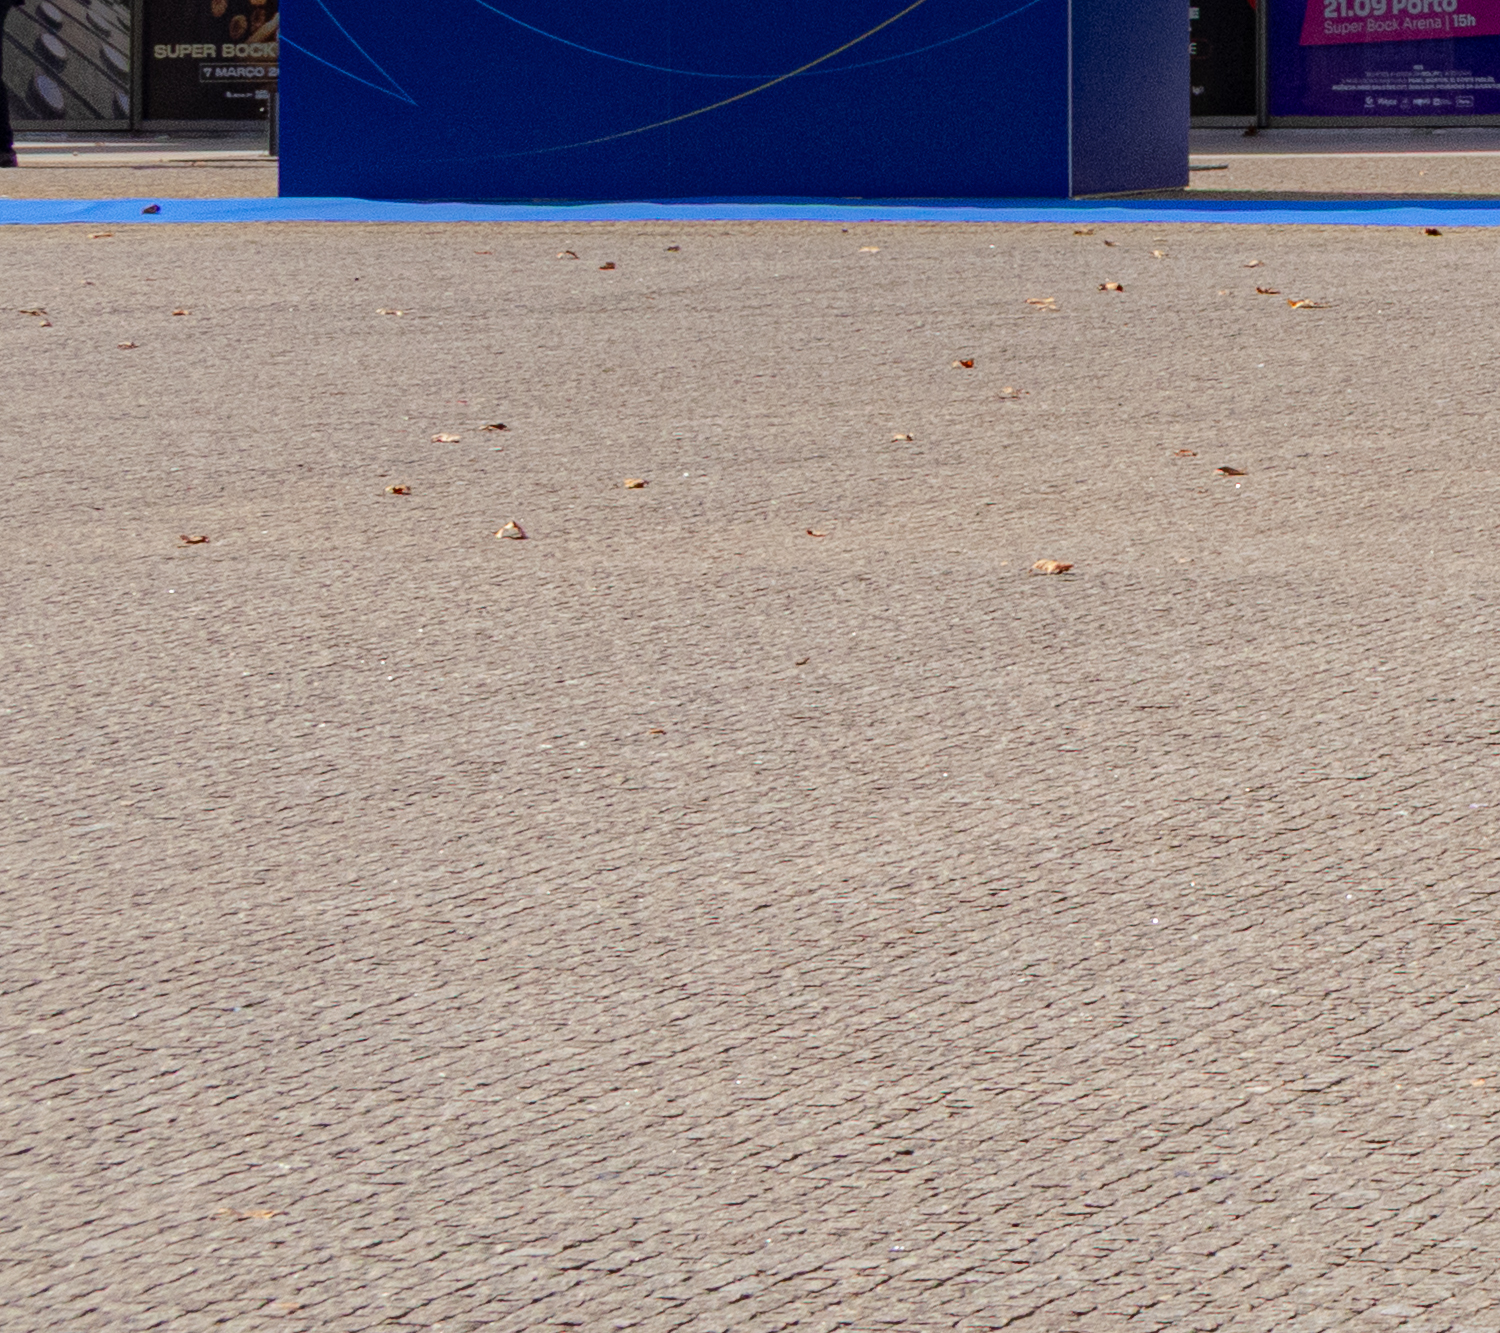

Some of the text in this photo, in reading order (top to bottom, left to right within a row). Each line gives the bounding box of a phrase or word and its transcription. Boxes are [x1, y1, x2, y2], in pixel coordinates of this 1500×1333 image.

[1323, 14, 1477, 35] Super Bock Arena 15h
[153, 43, 277, 59] SUPER BOCK
[203, 68, 212, 77] 7
[215, 67, 265, 79] MARÇO
